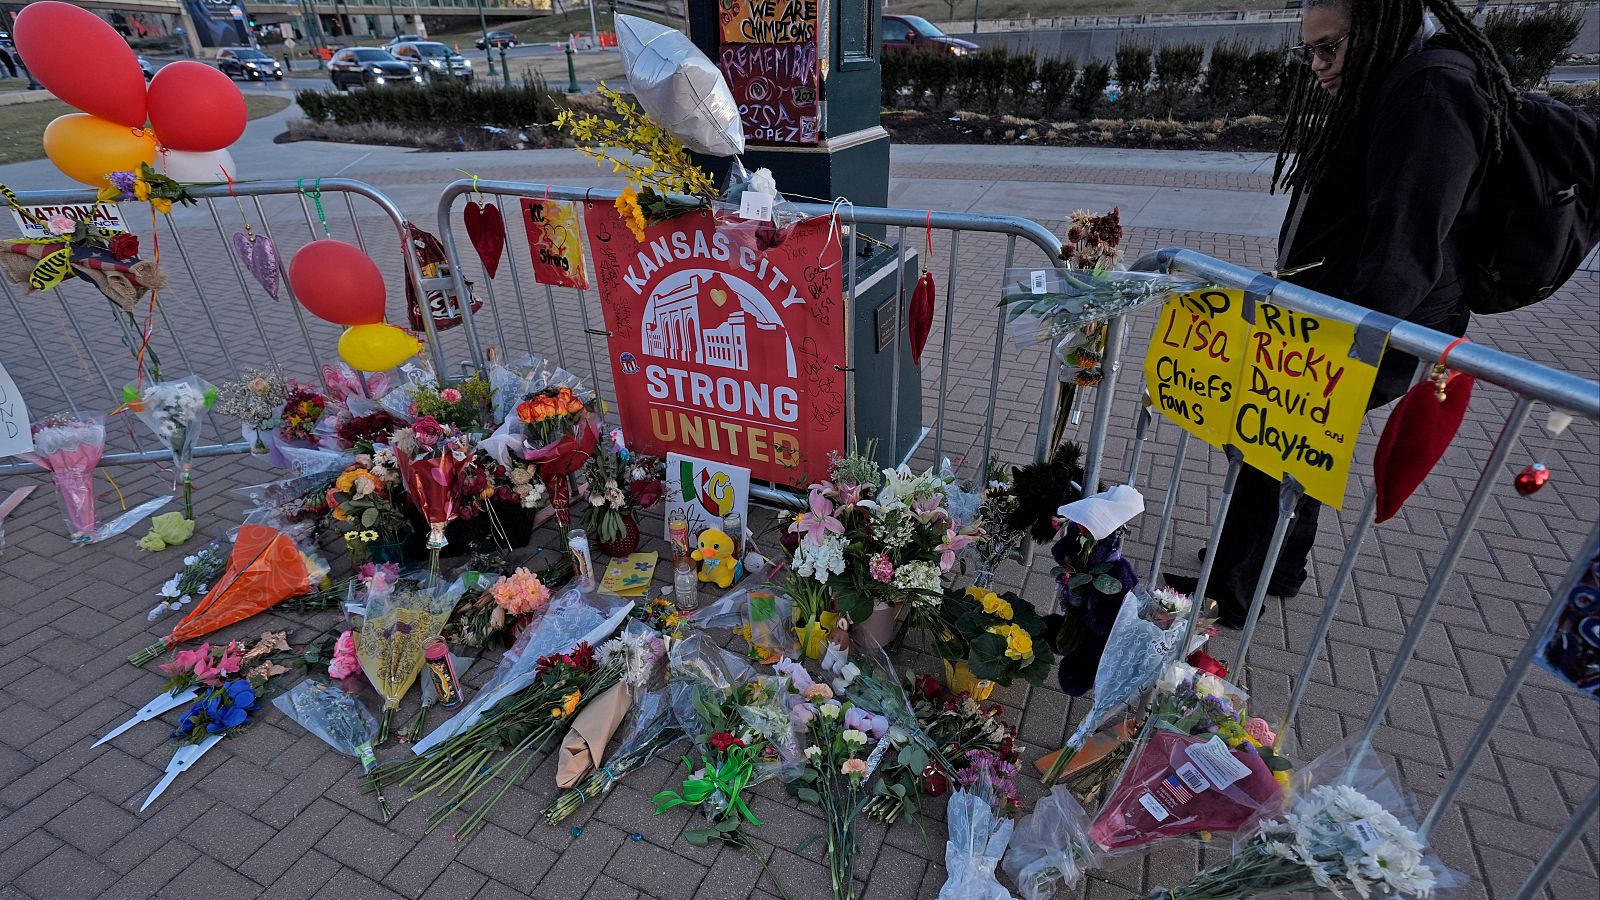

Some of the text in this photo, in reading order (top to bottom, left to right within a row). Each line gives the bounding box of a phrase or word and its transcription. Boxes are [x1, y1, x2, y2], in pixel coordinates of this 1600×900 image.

[748, 0, 817, 22] WE ARE
[528, 203, 545, 223] KC
[539, 248, 570, 272] Strong
[623, 230, 730, 295] KANSAS
[739, 246, 806, 309] CITY
[1162, 308, 1230, 363] Lisa
[1156, 356, 1232, 402] Chiefs
[1253, 331, 1345, 399] Ricky
[645, 364, 799, 423] STRONG
[1158, 382, 1205, 426] Fans
[1247, 364, 1332, 426] David
[650, 408, 800, 467] UNITED
[1235, 403, 1335, 472] Clayton
[1324, 430, 1345, 444] and
